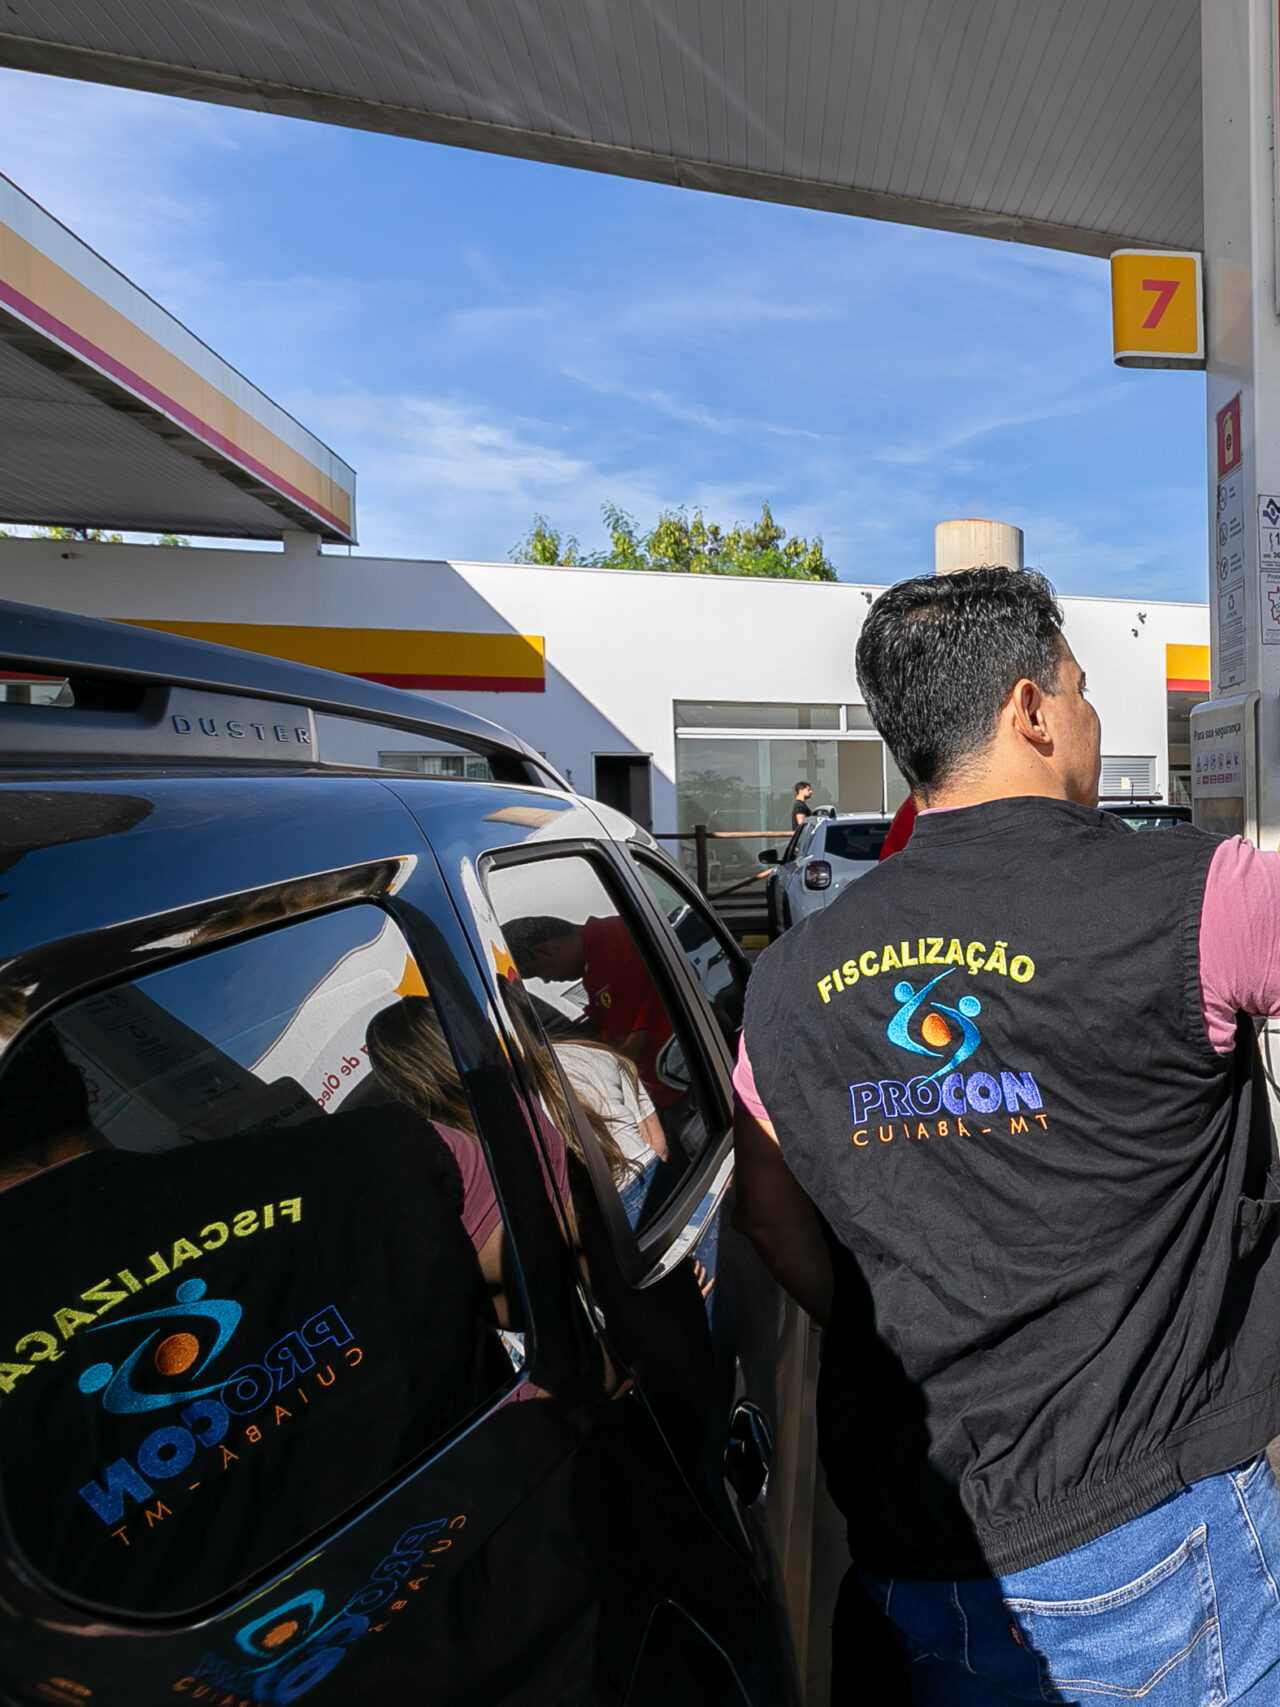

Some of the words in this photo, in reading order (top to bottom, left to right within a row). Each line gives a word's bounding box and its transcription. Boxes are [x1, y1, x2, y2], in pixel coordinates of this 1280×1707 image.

[1141, 280, 1180, 329] 7
[172, 715, 311, 744] DUSTER
[1194, 730, 1204, 741] Para
[1205, 729, 1214, 739] sua
[1215, 723, 1241, 739] segurança
[817, 937, 1036, 1004] FISCALIZAÇÃO
[850, 1071, 1044, 1124] PROCON
[853, 1115, 971, 1148] CUIABÁ
[1010, 1114, 1049, 1133] MT
